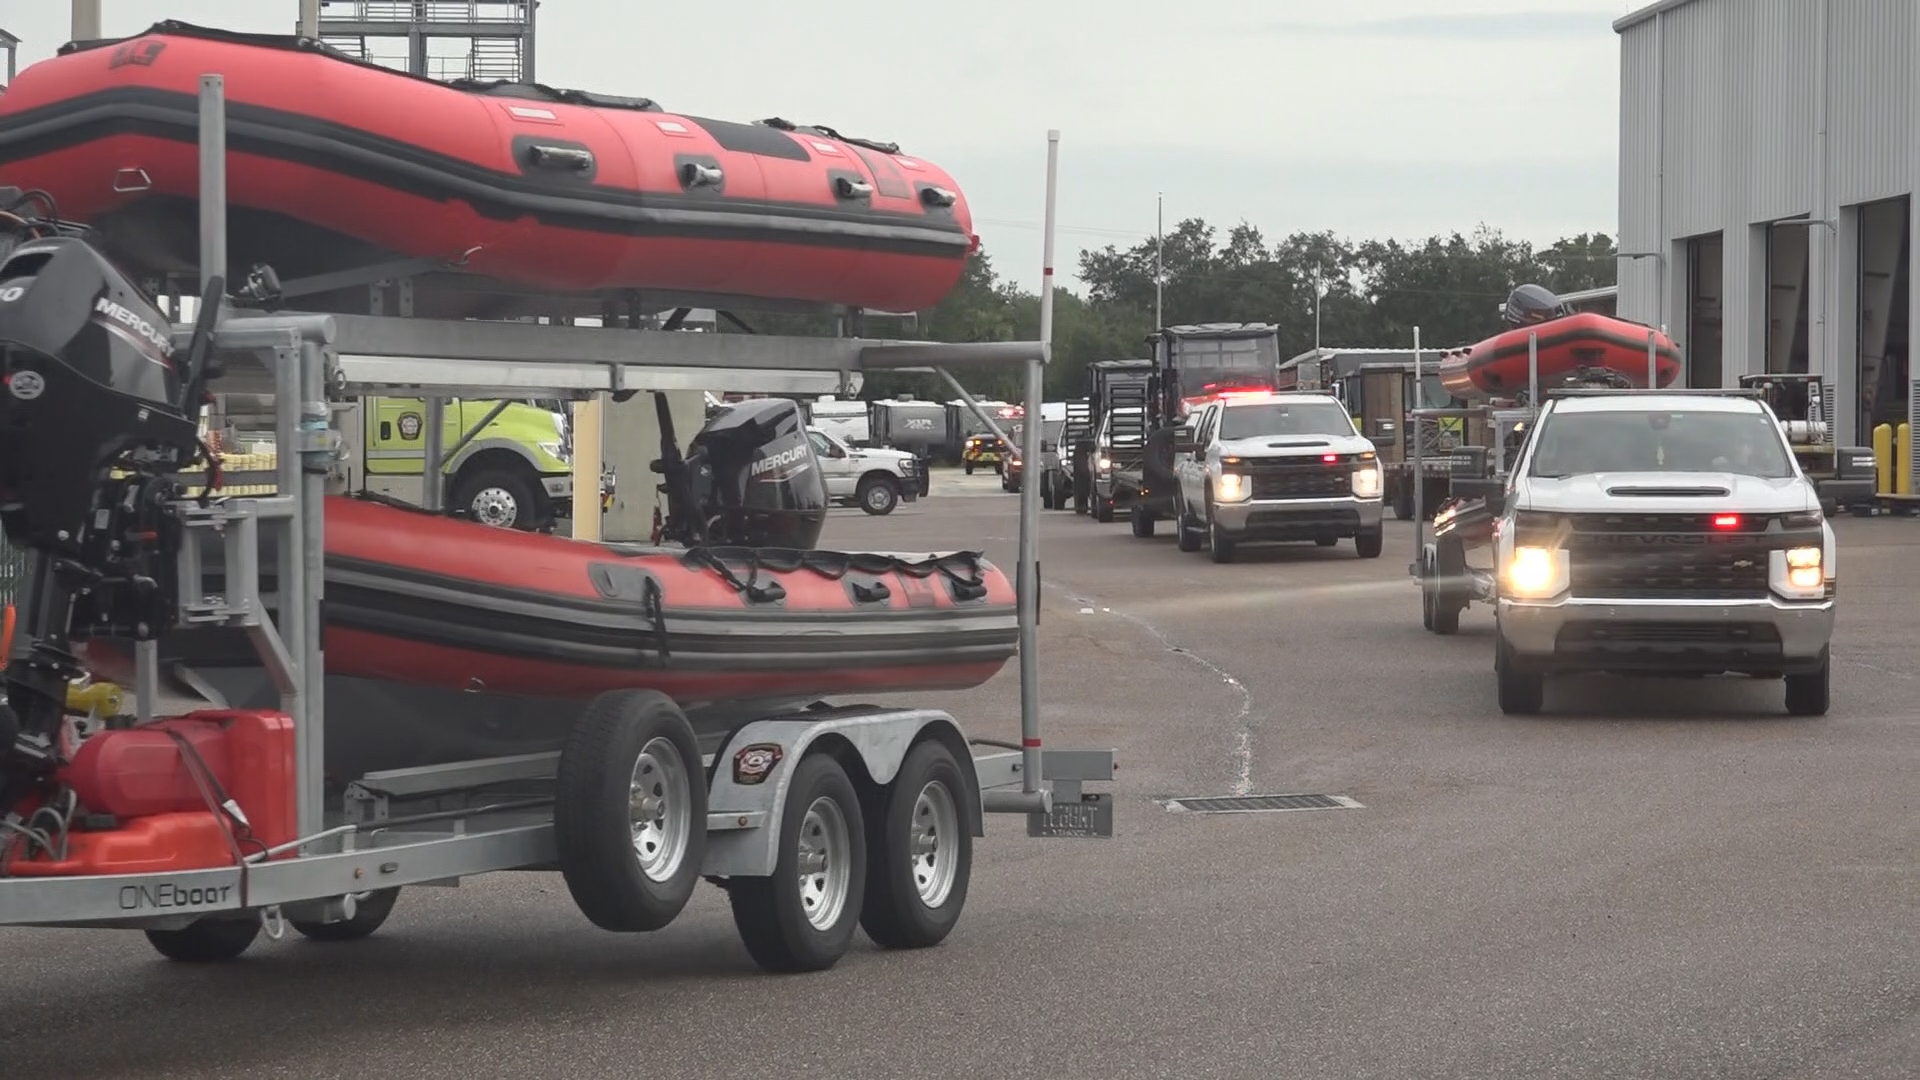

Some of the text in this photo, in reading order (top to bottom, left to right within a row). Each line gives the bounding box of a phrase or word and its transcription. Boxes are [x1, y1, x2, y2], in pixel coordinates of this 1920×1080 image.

[0, 287, 24, 301] 0
[95, 297, 175, 357] MERCURY
[751, 443, 808, 477] MERCURY
